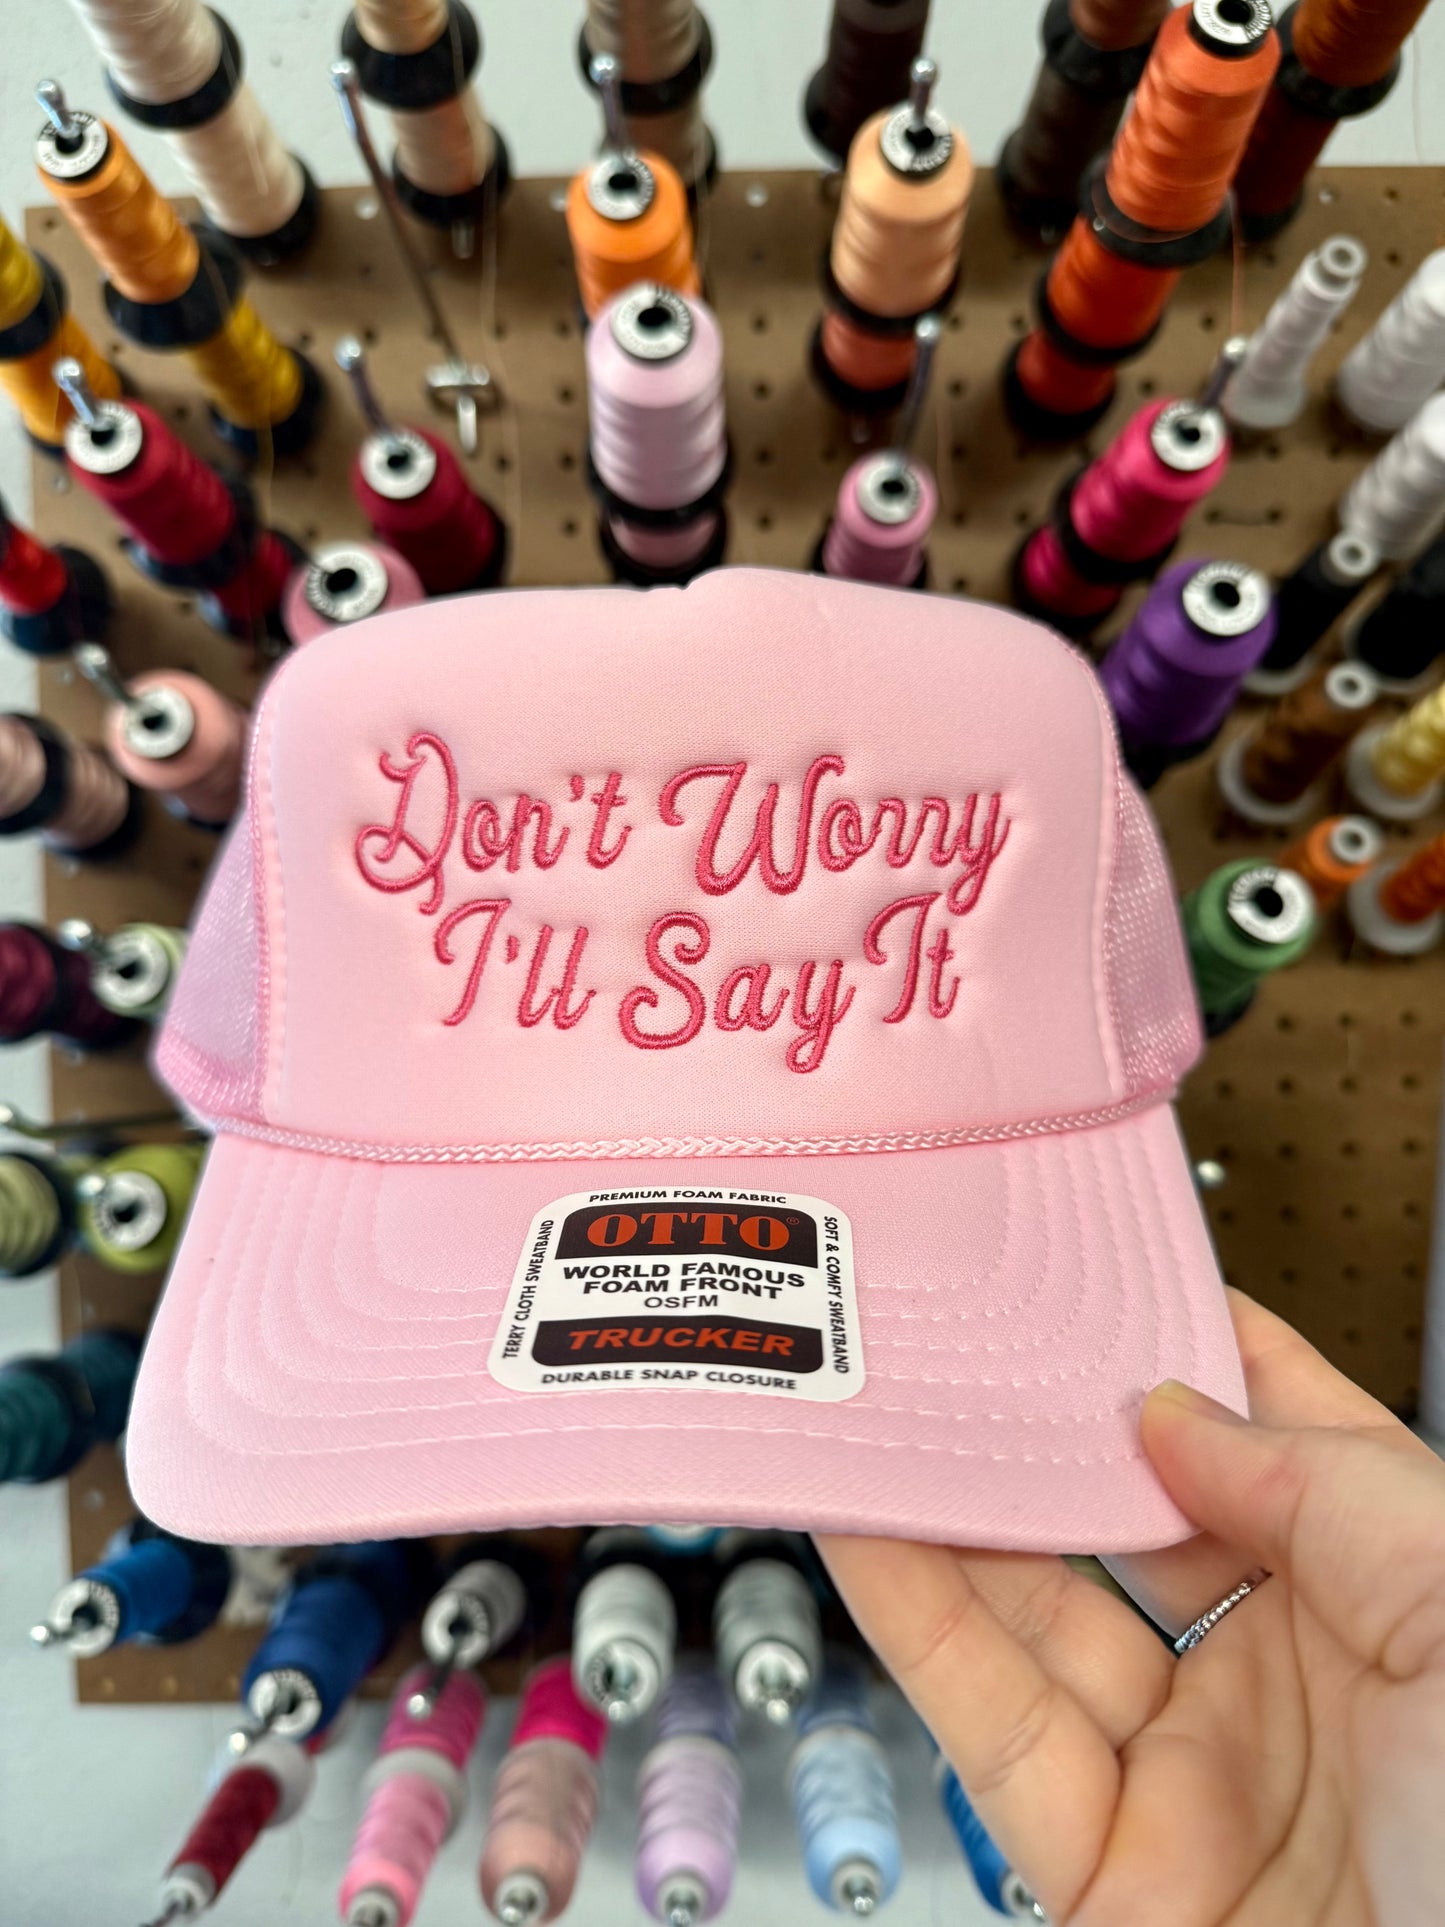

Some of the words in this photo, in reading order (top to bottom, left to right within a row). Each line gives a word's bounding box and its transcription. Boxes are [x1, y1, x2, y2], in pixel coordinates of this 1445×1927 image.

[355, 732, 633, 915] Don't
[659, 754, 1011, 915] Worry
[434, 898, 597, 1030] I'll
[618, 911, 856, 1074] Say
[863, 892, 961, 1024] It
[589, 1190, 668, 1203] PREMIUM
[673, 1190, 724, 1200] FOAM
[729, 1192, 787, 1205] FABRIC
[824, 1216, 839, 1242] SOFT
[525, 1219, 555, 1282] SWEATBAND
[825, 1243, 840, 1252] &
[563, 1263, 671, 1280] WORLD
[681, 1262, 806, 1288] FAMOUS
[583, 1280, 669, 1294] FOAM
[680, 1277, 783, 1300] FRONT
[826, 1256, 843, 1299] COMFY
[514, 1285, 538, 1321] CLOTH
[643, 1295, 719, 1309] OSFM
[502, 1324, 527, 1359] TERRY
[568, 1327, 795, 1357] TRUCKER
[828, 1300, 850, 1374] SWEATBAND
[541, 1368, 634, 1384] DURABLE
[640, 1368, 700, 1381] SNAP
[706, 1371, 798, 1390] CLOSURE
